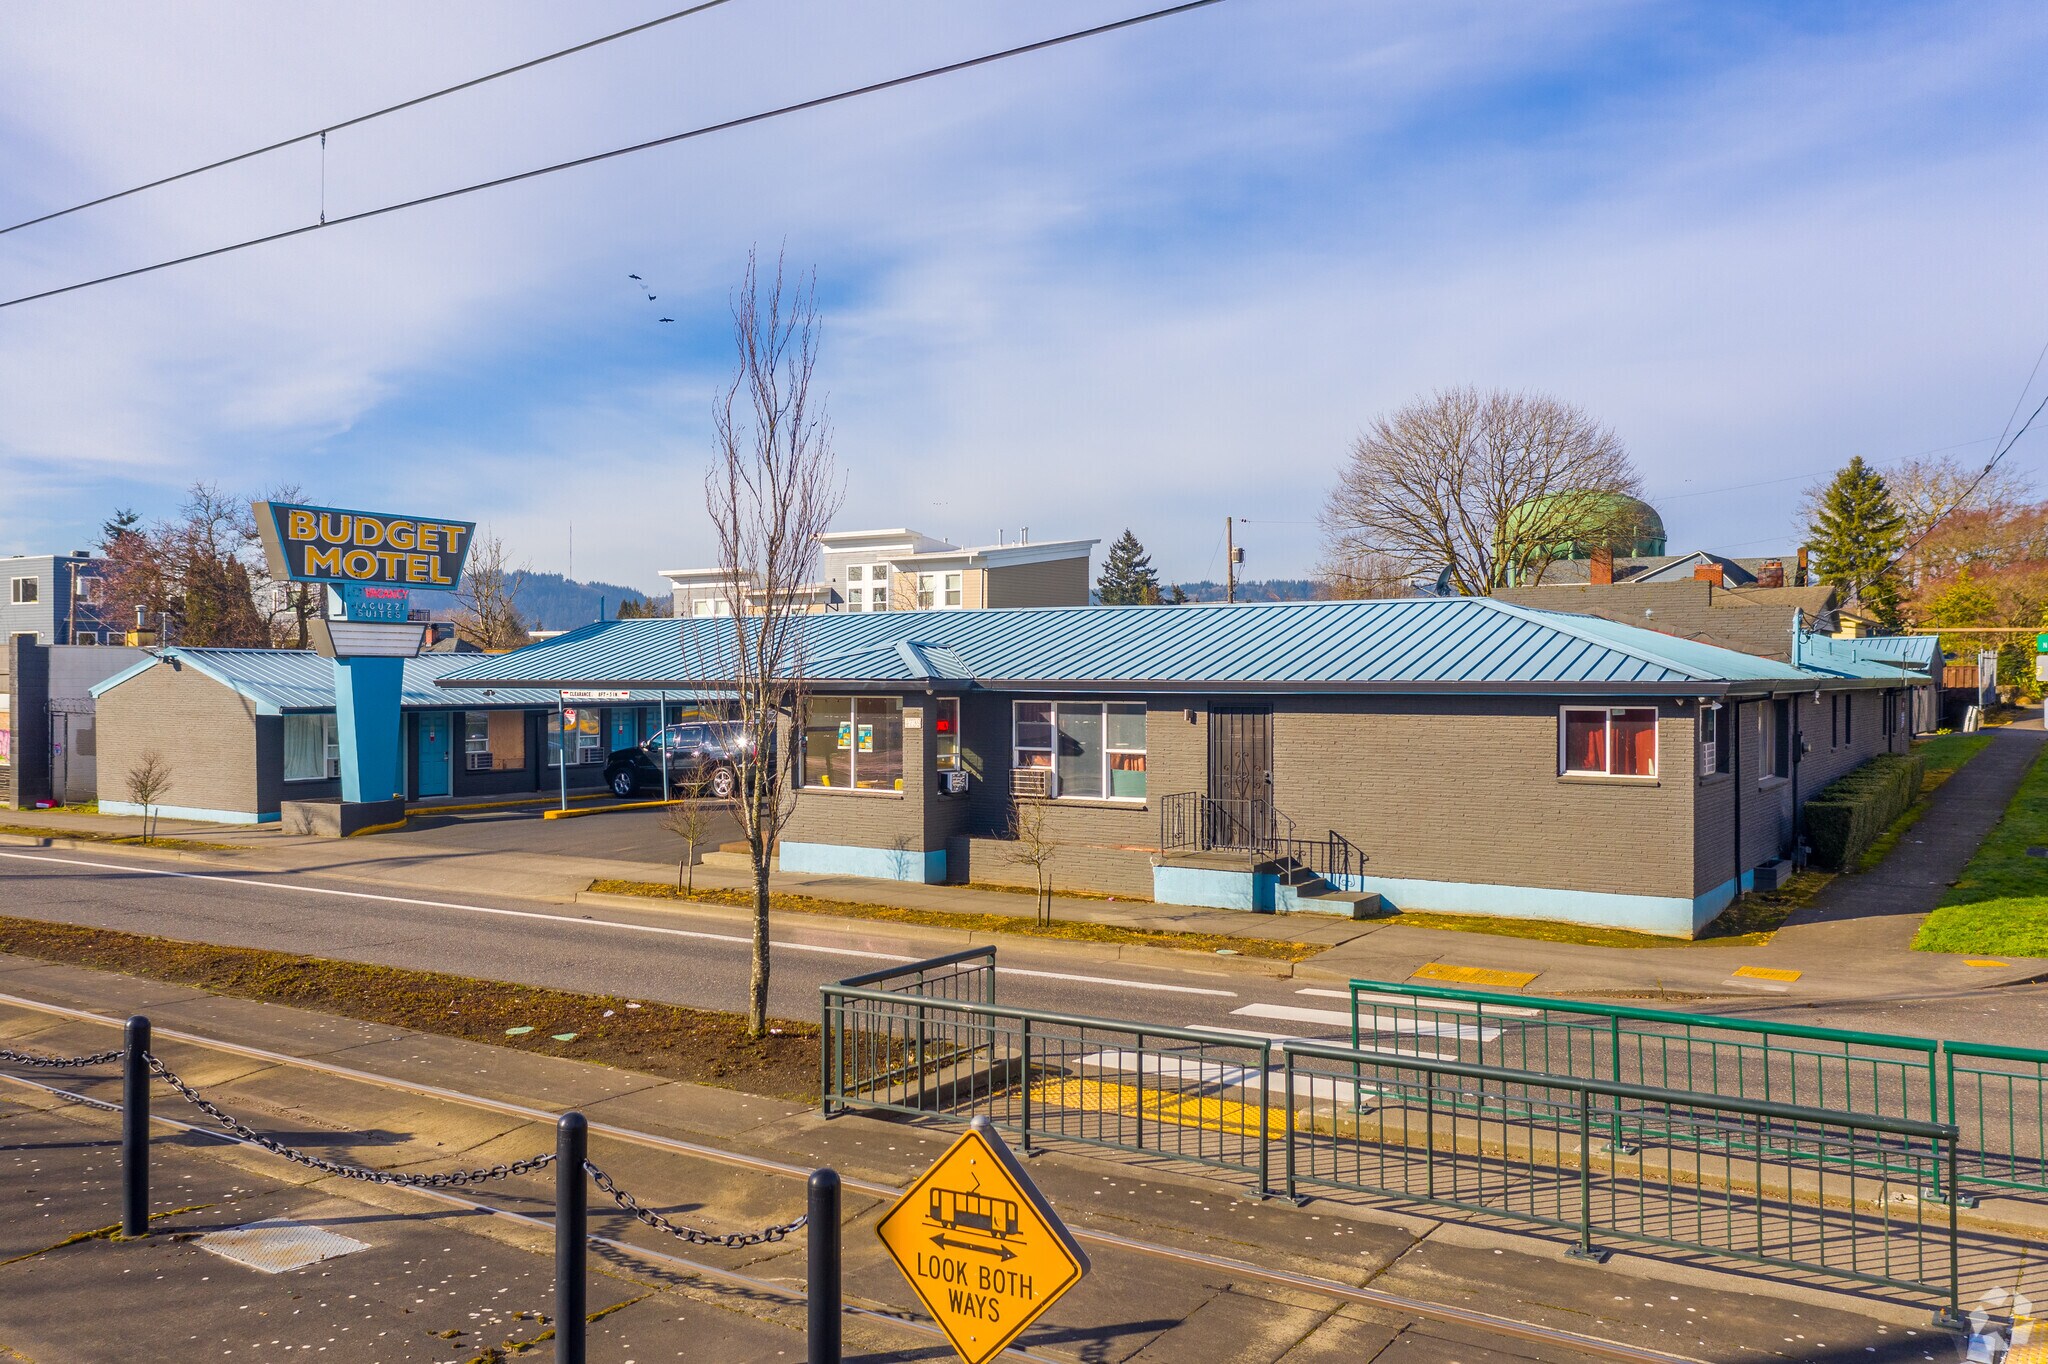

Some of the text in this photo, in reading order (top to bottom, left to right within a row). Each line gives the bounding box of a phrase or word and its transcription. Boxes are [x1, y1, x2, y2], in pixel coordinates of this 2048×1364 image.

[288, 509, 466, 553] BUDGET
[304, 545, 452, 584] MOTEL
[354, 602, 405, 611] JACUZZI
[365, 587, 409, 599] VACANCY
[358, 609, 401, 619] SUITES
[917, 1252, 1033, 1300] LOOK BOTH
[948, 1287, 1000, 1323] WAYS
